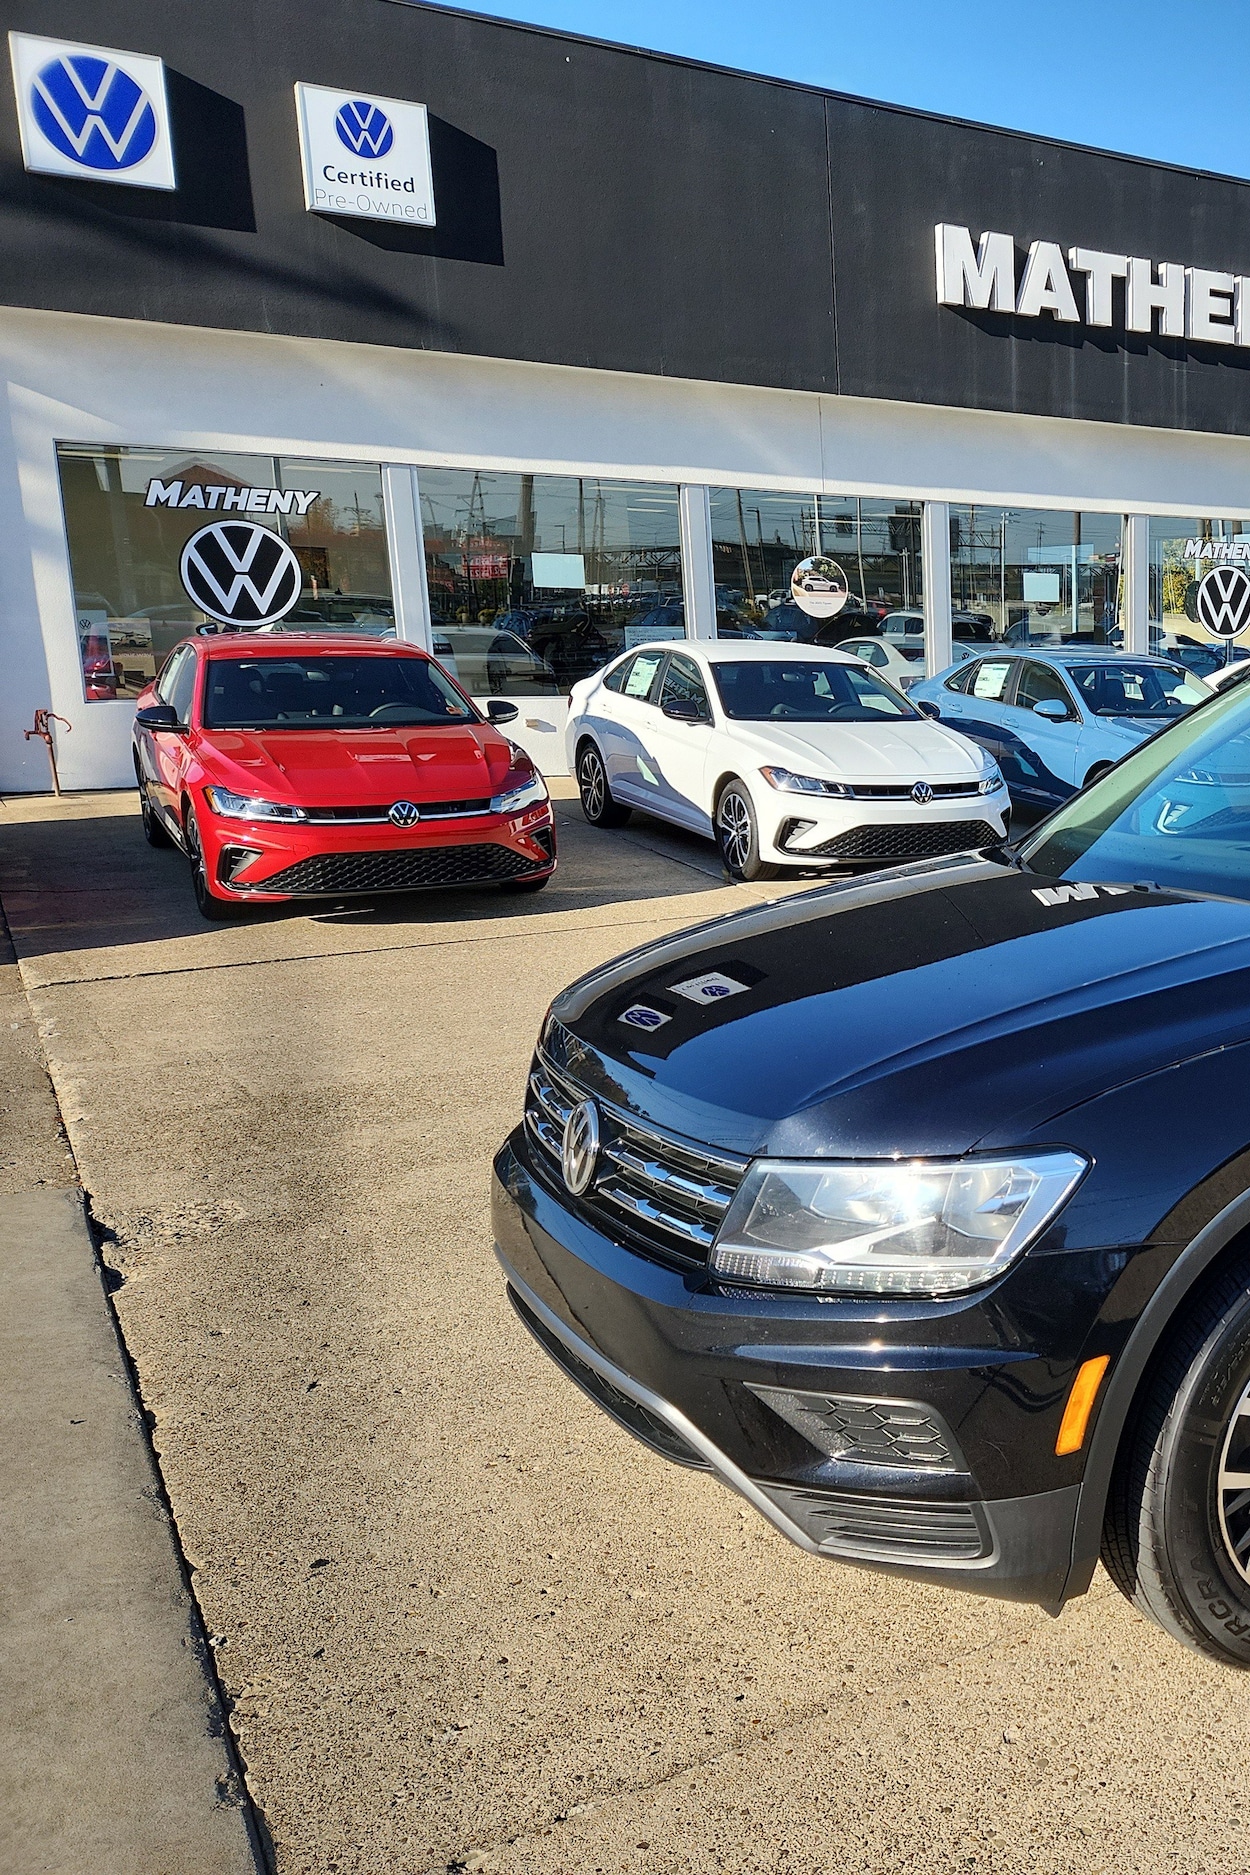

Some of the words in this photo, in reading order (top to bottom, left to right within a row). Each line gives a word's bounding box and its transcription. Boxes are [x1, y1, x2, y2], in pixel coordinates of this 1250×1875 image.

[322, 164, 416, 194] Certified
[313, 187, 429, 221] Pre-Owned
[143, 478, 322, 515] MATHENY
